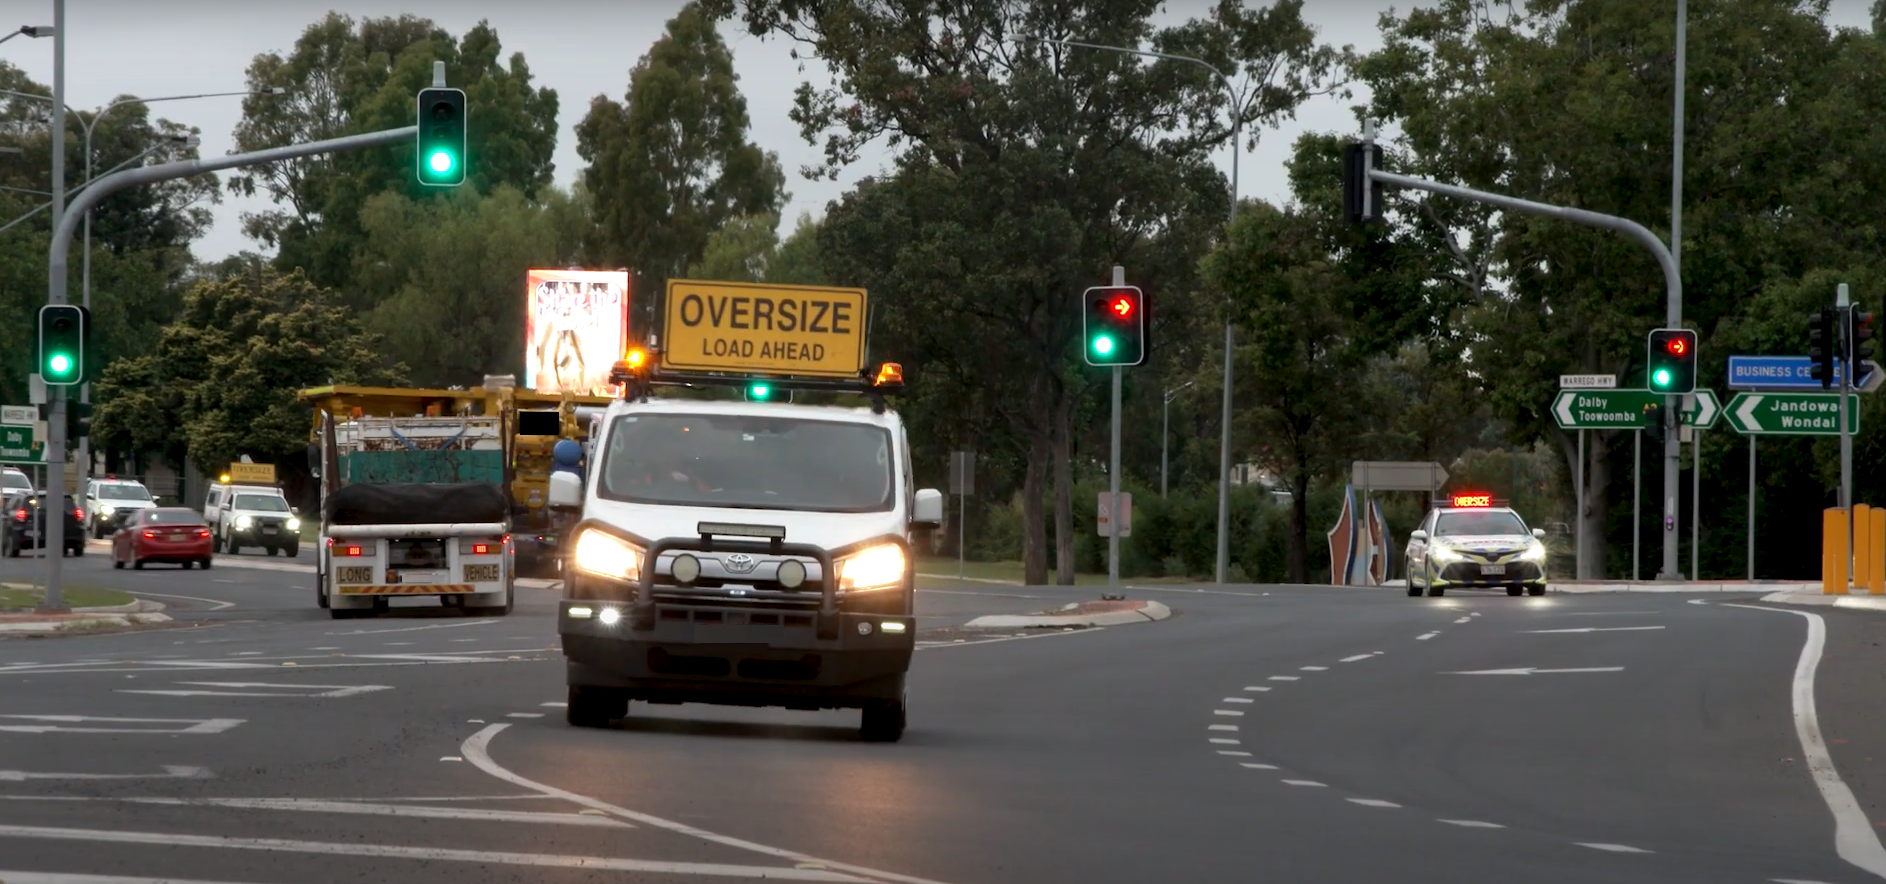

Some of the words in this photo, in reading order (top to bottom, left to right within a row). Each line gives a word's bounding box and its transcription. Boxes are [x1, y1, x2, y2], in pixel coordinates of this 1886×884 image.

[680, 294, 852, 334] OVERSIZE
[702, 338, 754, 358] LOAD
[759, 341, 825, 361] AHEAD
[1736, 366, 1792, 377] BUSINESS
[1563, 375, 1596, 386] WARREGO
[1597, 375, 1613, 386] HWY
[1578, 396, 1608, 409] Dalby
[1770, 400, 1842, 412] Jandowa
[1578, 410, 1636, 422] Toowoomba
[1781, 416, 1836, 428] Wondai
[1454, 496, 1490, 507] OVERSIZE
[339, 568, 371, 583] LONG
[464, 564, 499, 580] VEHICLE
